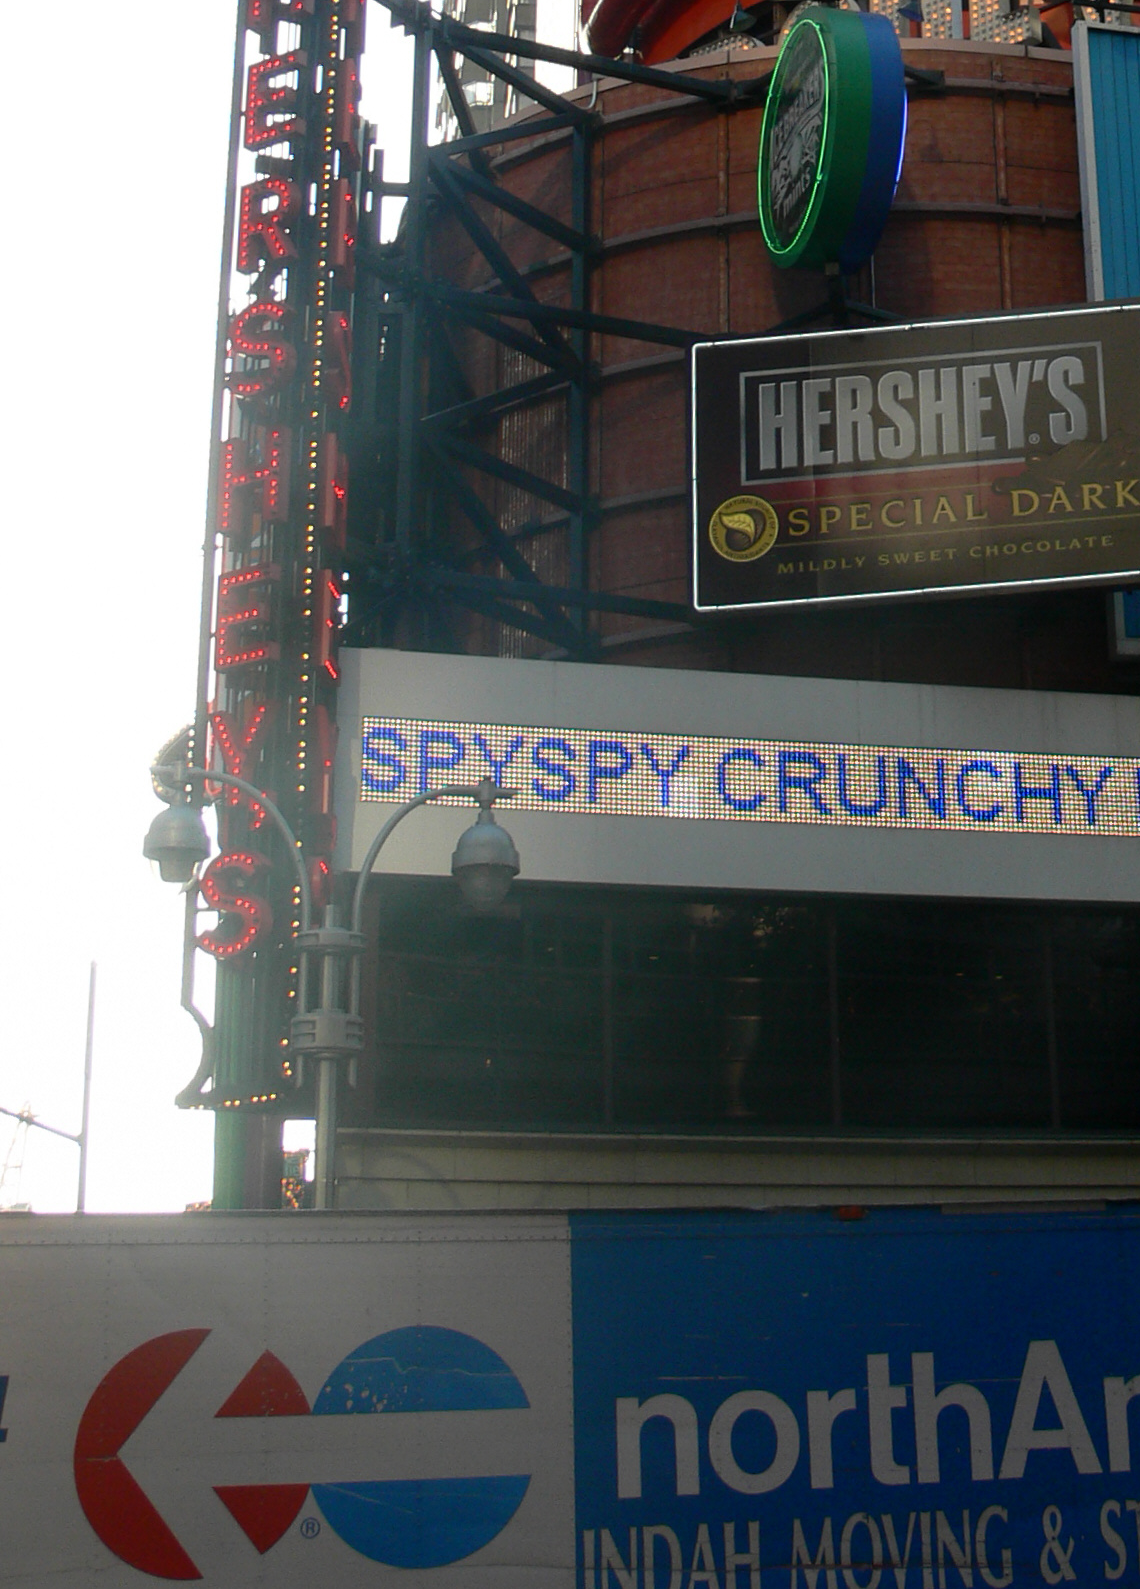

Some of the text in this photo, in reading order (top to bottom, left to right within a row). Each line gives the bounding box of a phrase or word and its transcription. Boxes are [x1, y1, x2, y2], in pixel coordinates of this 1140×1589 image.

[758, 355, 1089, 471] HERSHEY'S
[777, 534, 1115, 574] MILDLY SWEET CHOCOLATE
[787, 494, 988, 537] SPECIAL
[719, 747, 1115, 826] CRUNCHY
[583, 1520, 760, 1589] INDAH
[792, 1505, 1013, 1589] MOVING
[1040, 1504, 1077, 1585] &
